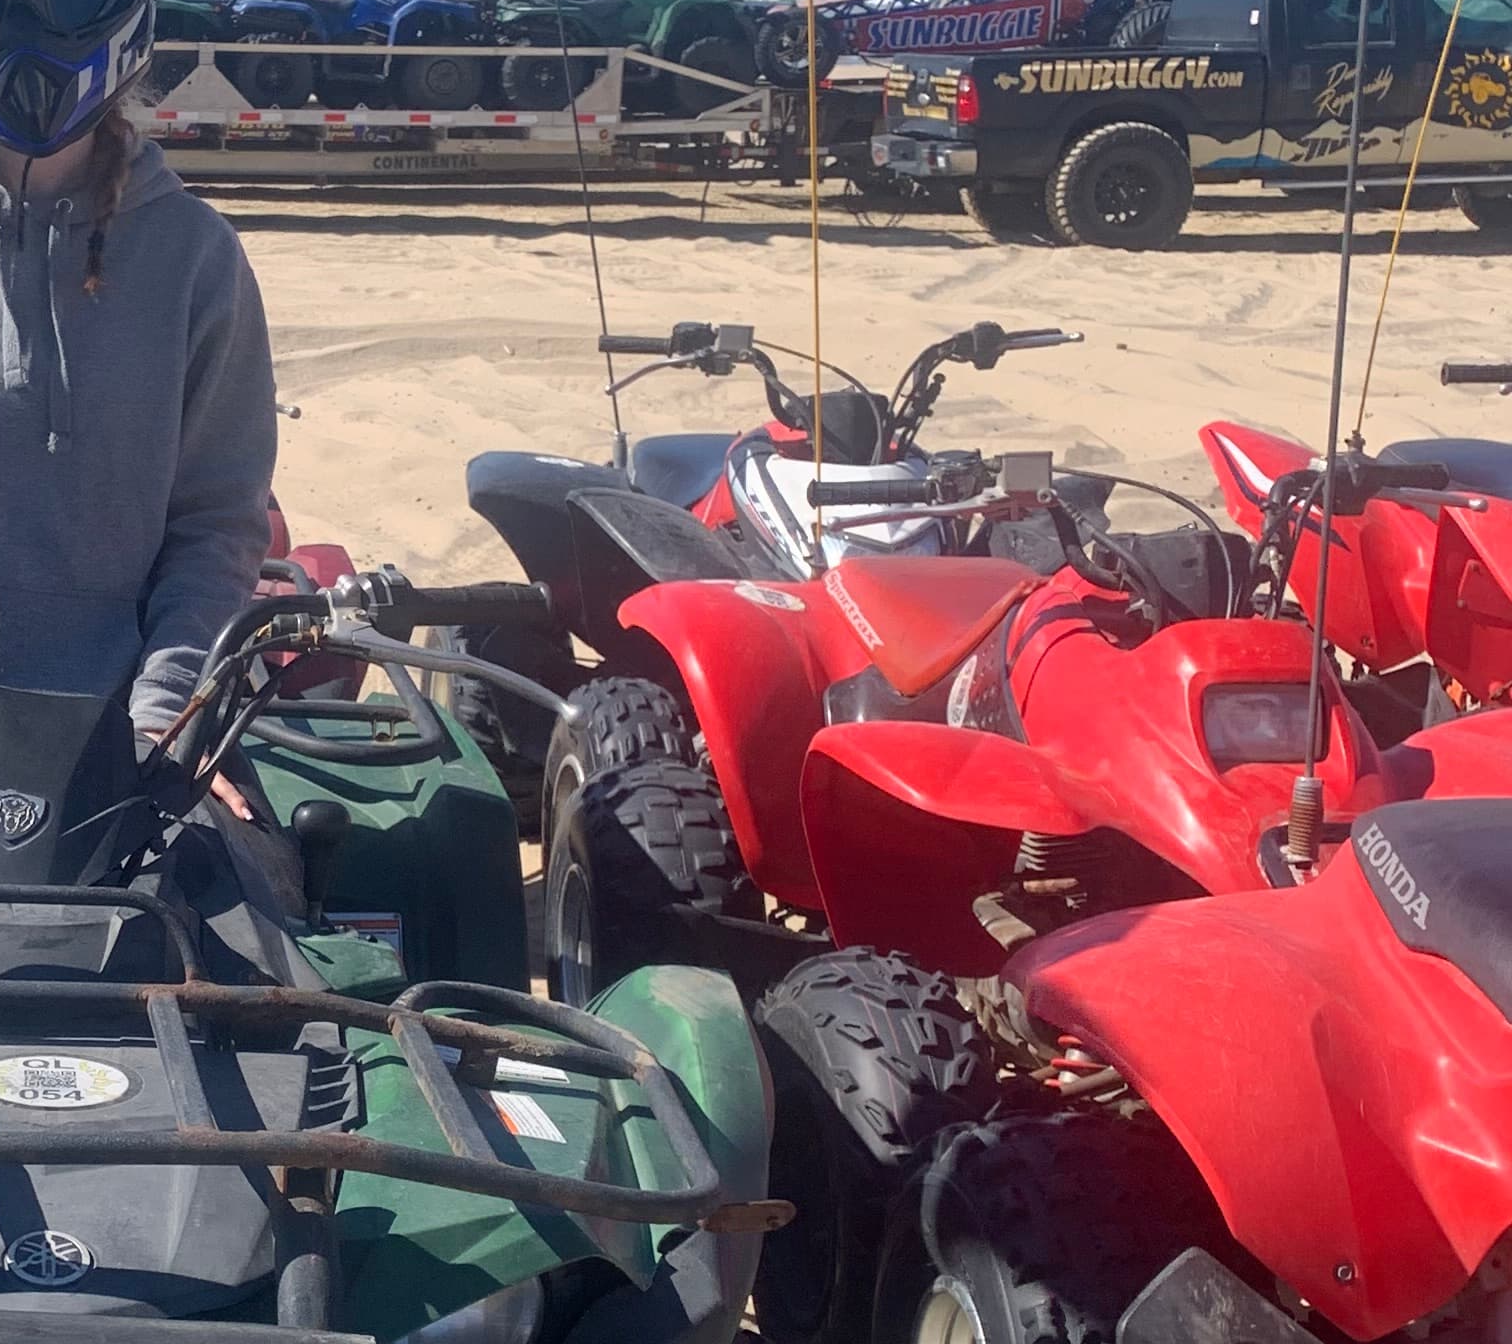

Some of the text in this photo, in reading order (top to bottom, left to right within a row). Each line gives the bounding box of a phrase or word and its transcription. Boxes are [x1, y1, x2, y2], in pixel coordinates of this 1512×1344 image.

[868, 6, 1045, 51] SUNBUGGIE
[374, 155, 478, 170] CONTINENTAL
[827, 572, 878, 643] Sportrax
[1357, 822, 1431, 930] HONDA
[22, 1059, 75, 1069] QL
[19, 1089, 85, 1101] 054
